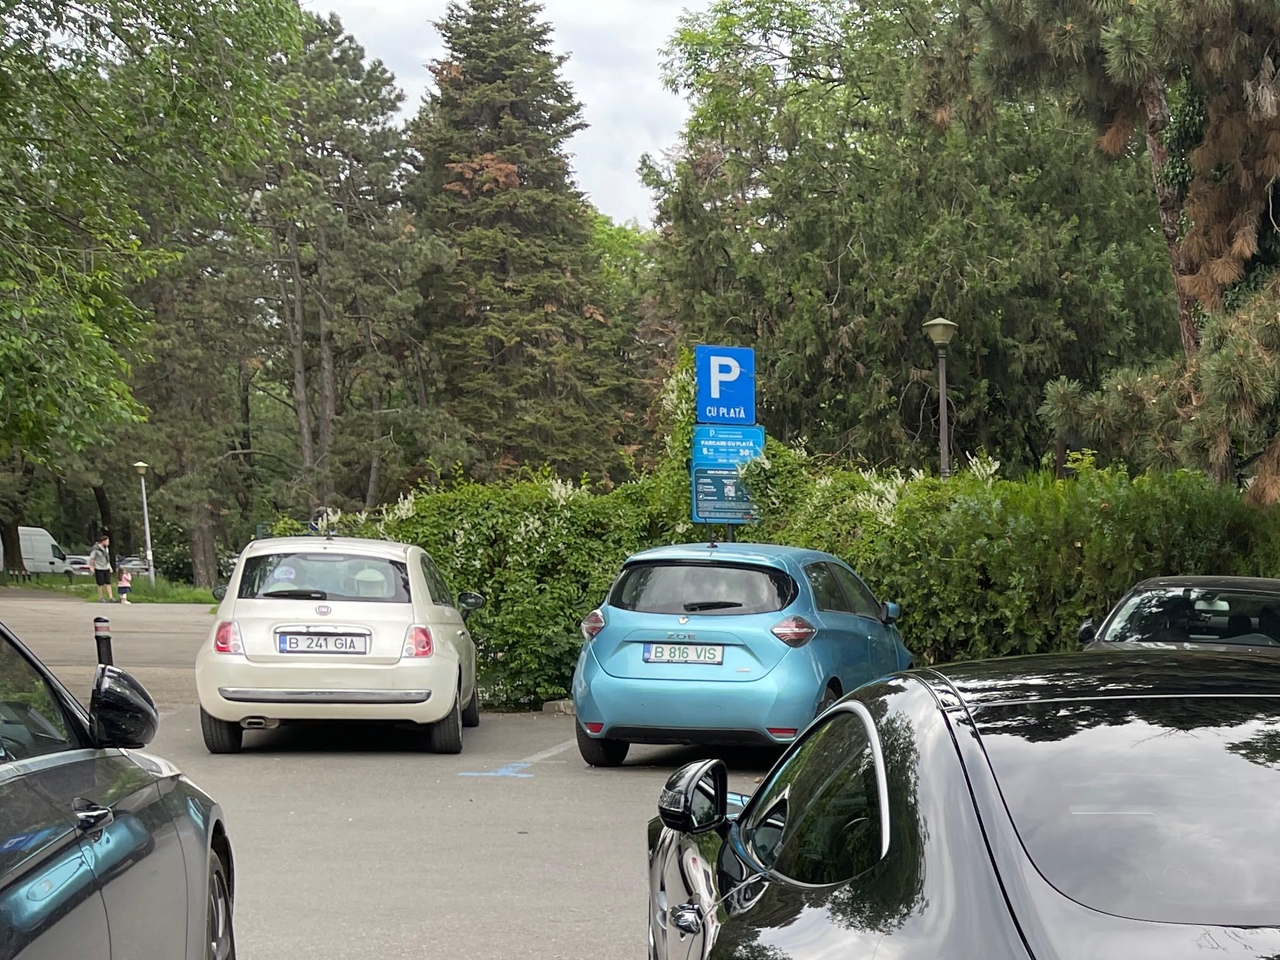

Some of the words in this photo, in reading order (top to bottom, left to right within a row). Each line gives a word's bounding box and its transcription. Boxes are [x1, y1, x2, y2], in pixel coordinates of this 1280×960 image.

[710, 356, 740, 398] P
[706, 406, 717, 417] CU
[719, 405, 745, 418] PLATĂ
[667, 632, 697, 640] ZOE
[289, 637, 299, 649] B
[306, 637, 328, 649] 241
[334, 638, 356, 650] GIA
[655, 646, 664, 658] B
[668, 646, 689, 659] 816
[695, 647, 717, 660] VIS
